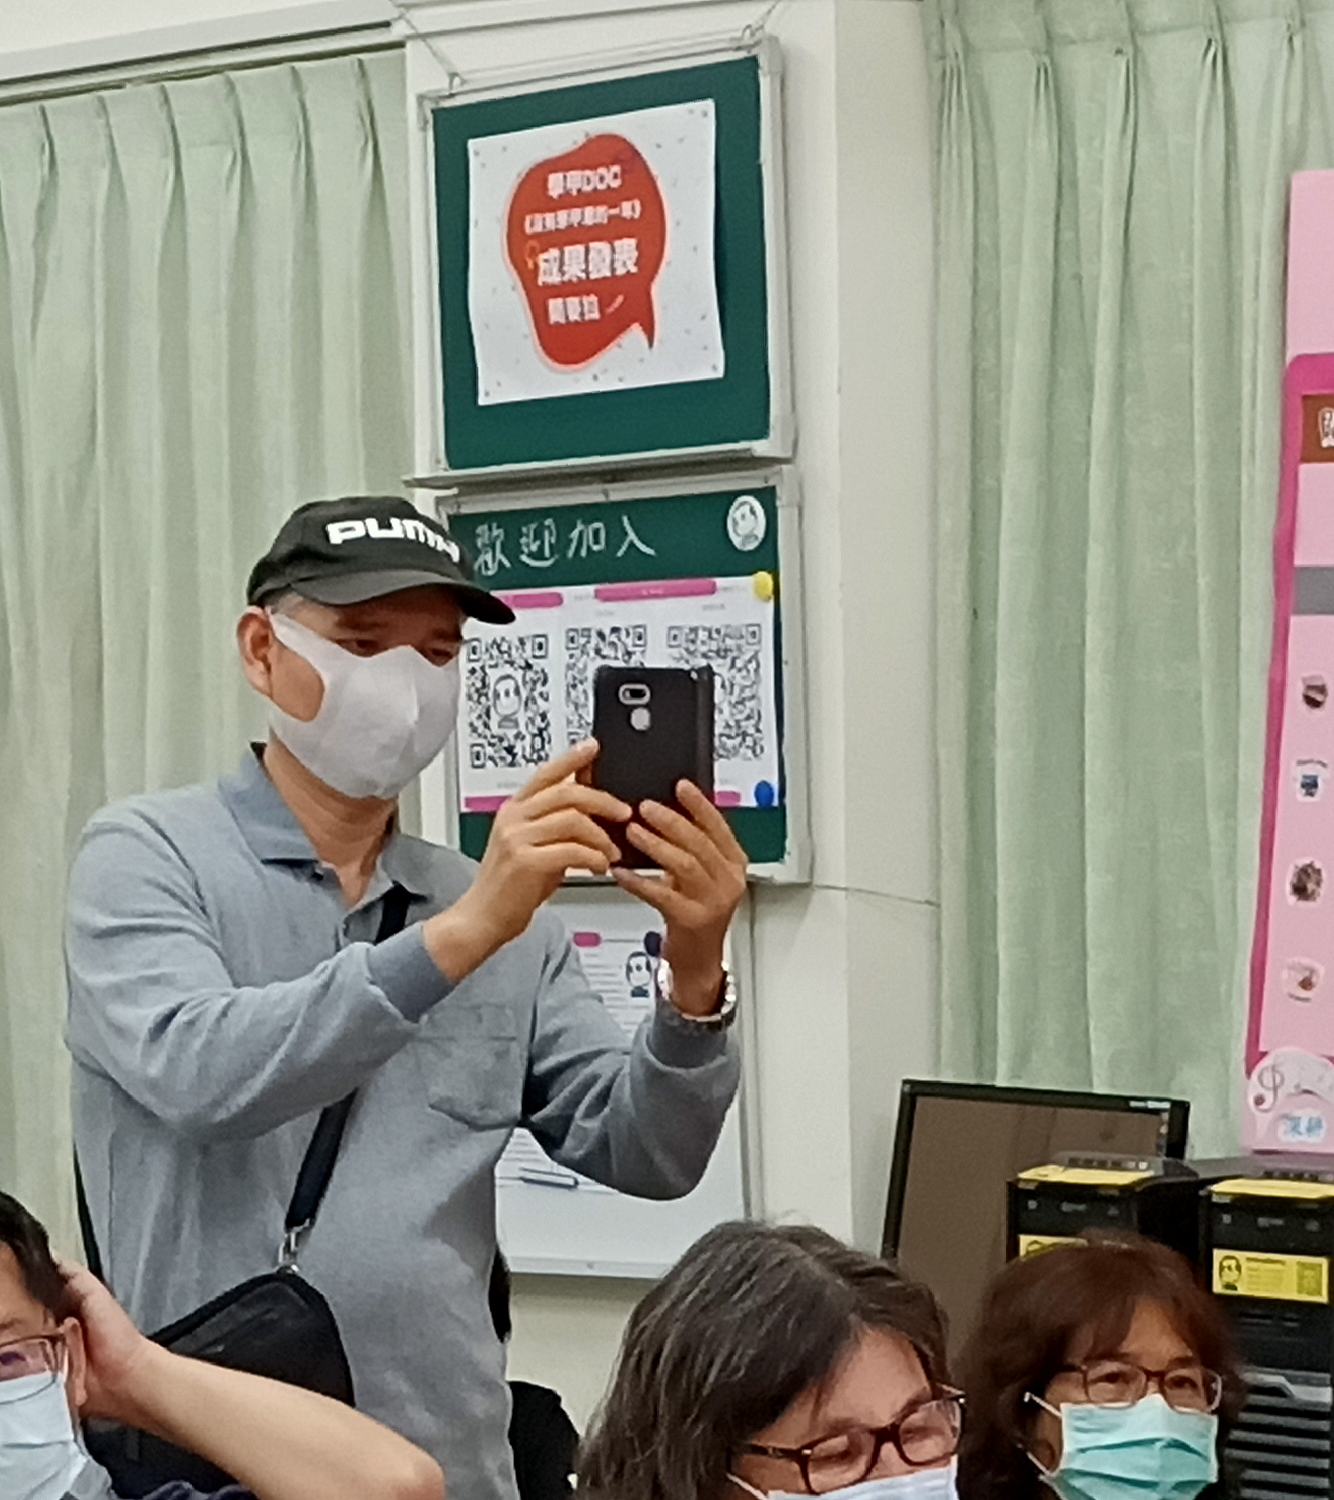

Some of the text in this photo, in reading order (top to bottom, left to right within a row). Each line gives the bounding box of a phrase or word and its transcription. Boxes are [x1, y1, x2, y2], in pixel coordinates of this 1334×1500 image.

[537, 237, 639, 286] 成果發表
[472, 514, 657, 577] 歡迎加入
